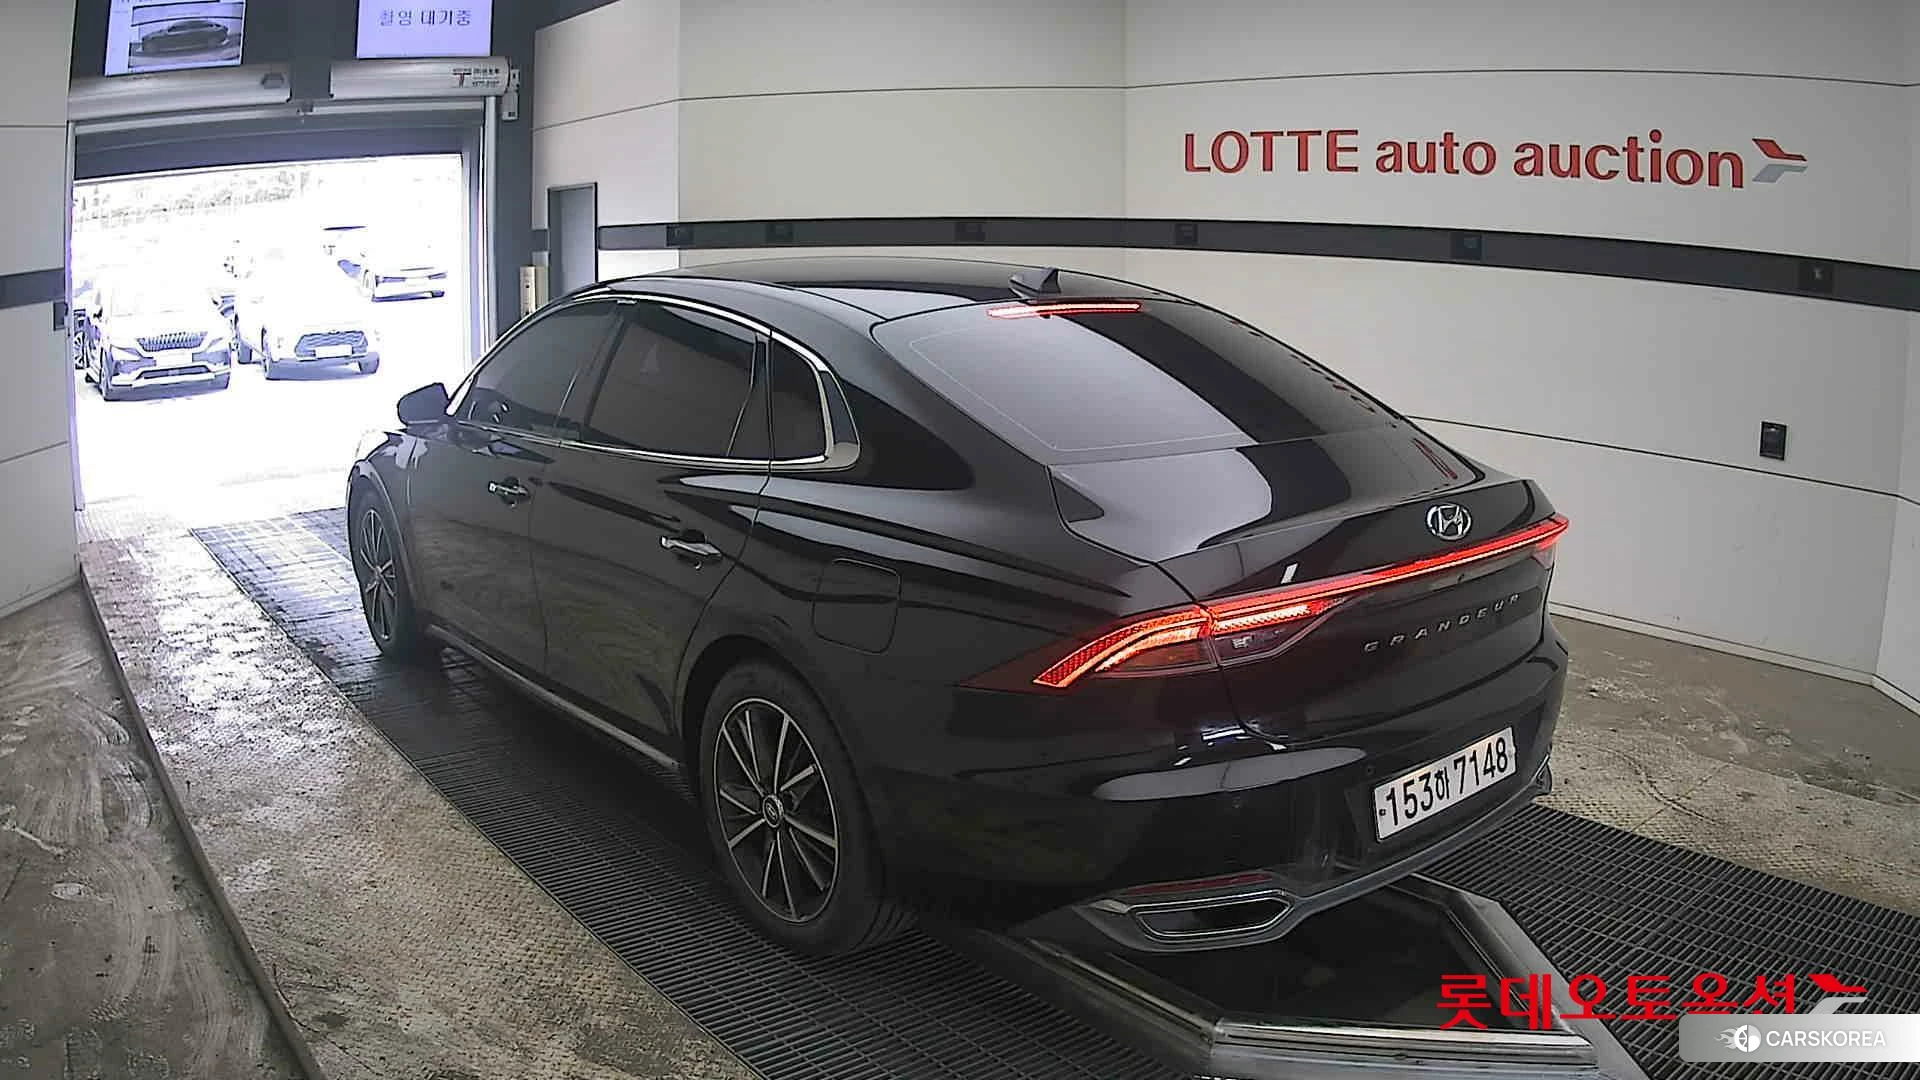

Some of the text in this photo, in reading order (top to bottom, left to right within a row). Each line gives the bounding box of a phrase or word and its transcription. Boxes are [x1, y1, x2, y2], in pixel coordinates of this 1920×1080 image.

[421, 9, 471, 26] 대기중
[1185, 129, 1744, 188] LOTTE auto auction
[1364, 593, 1520, 652] GRANDEUR
[1386, 737, 1508, 826] 153하 7148
